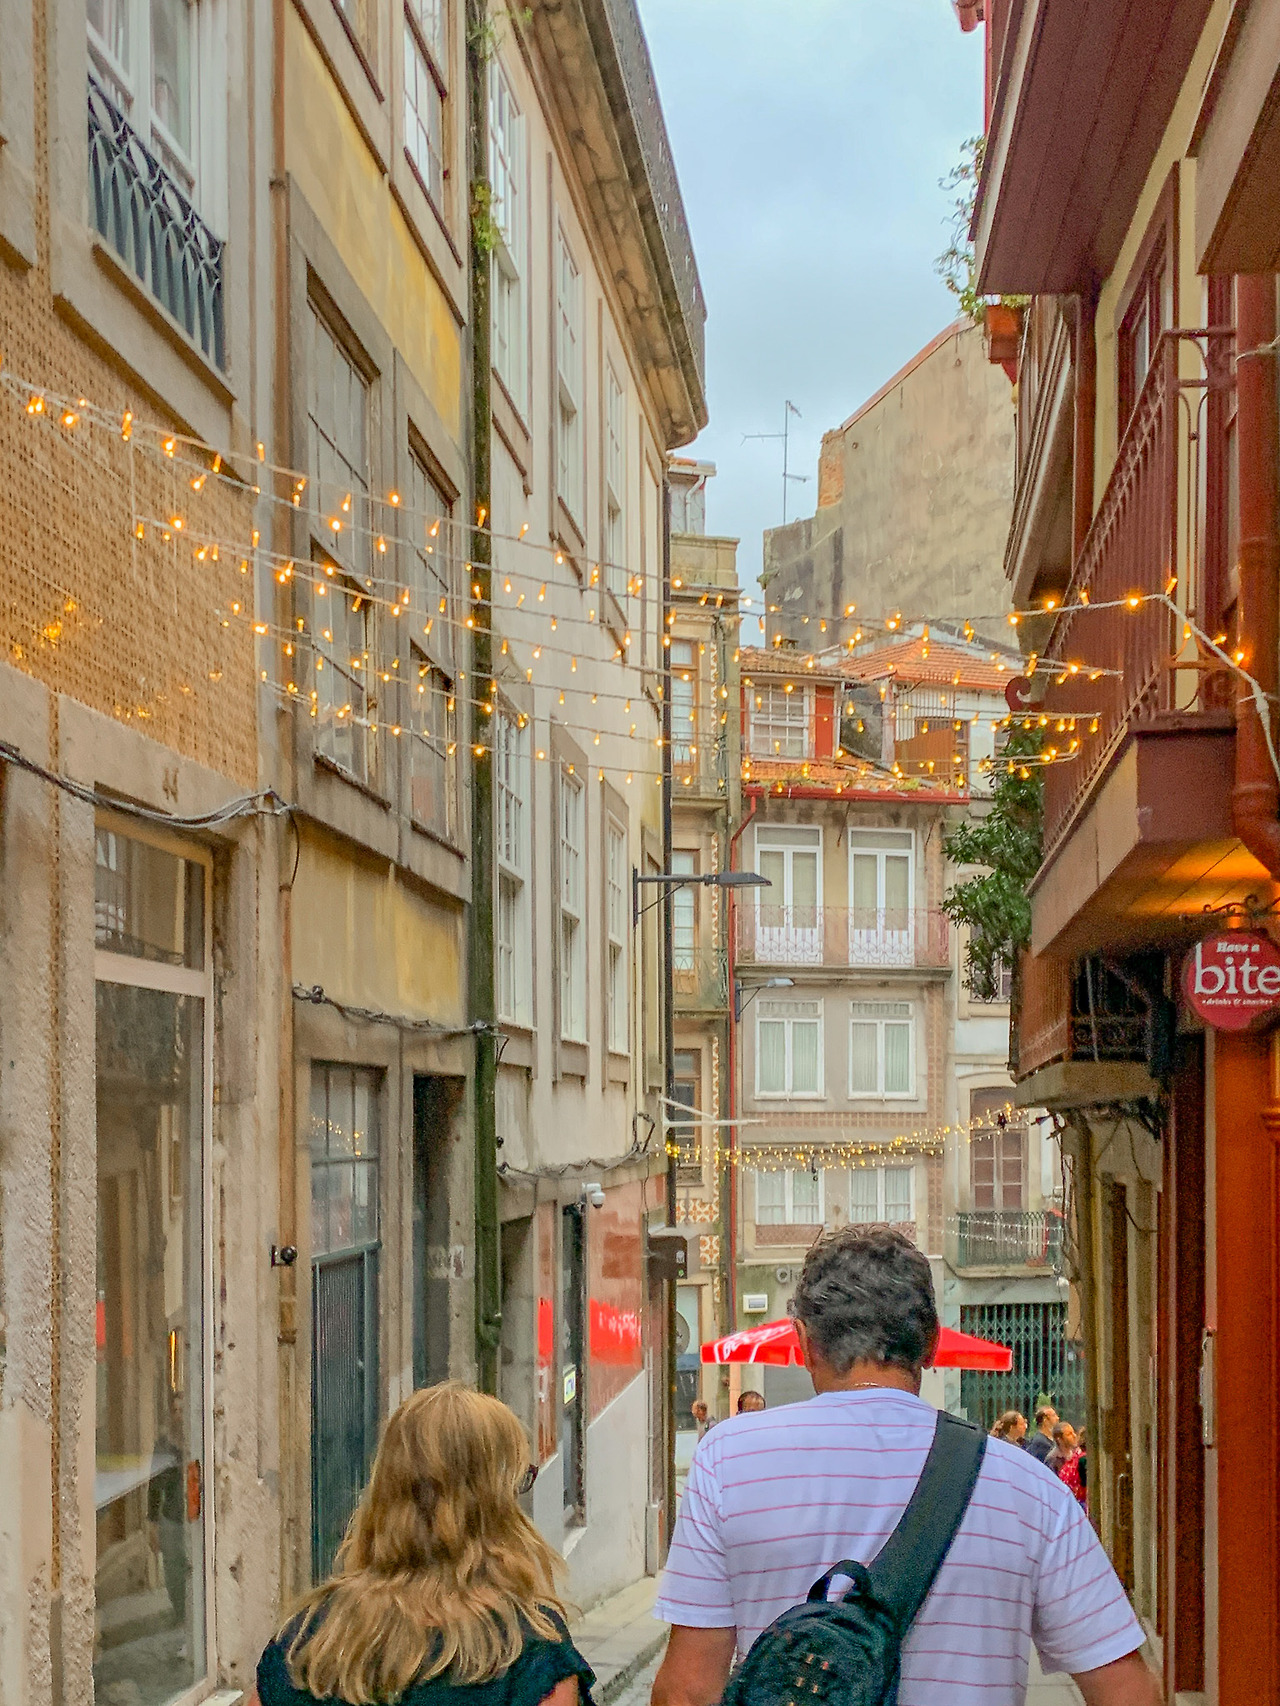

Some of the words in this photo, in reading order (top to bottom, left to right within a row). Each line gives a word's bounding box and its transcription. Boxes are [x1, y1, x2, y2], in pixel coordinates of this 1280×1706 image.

[1217, 942, 1249, 952] Have
[1251, 944, 1260, 952] a
[1195, 942, 1280, 994] bite
